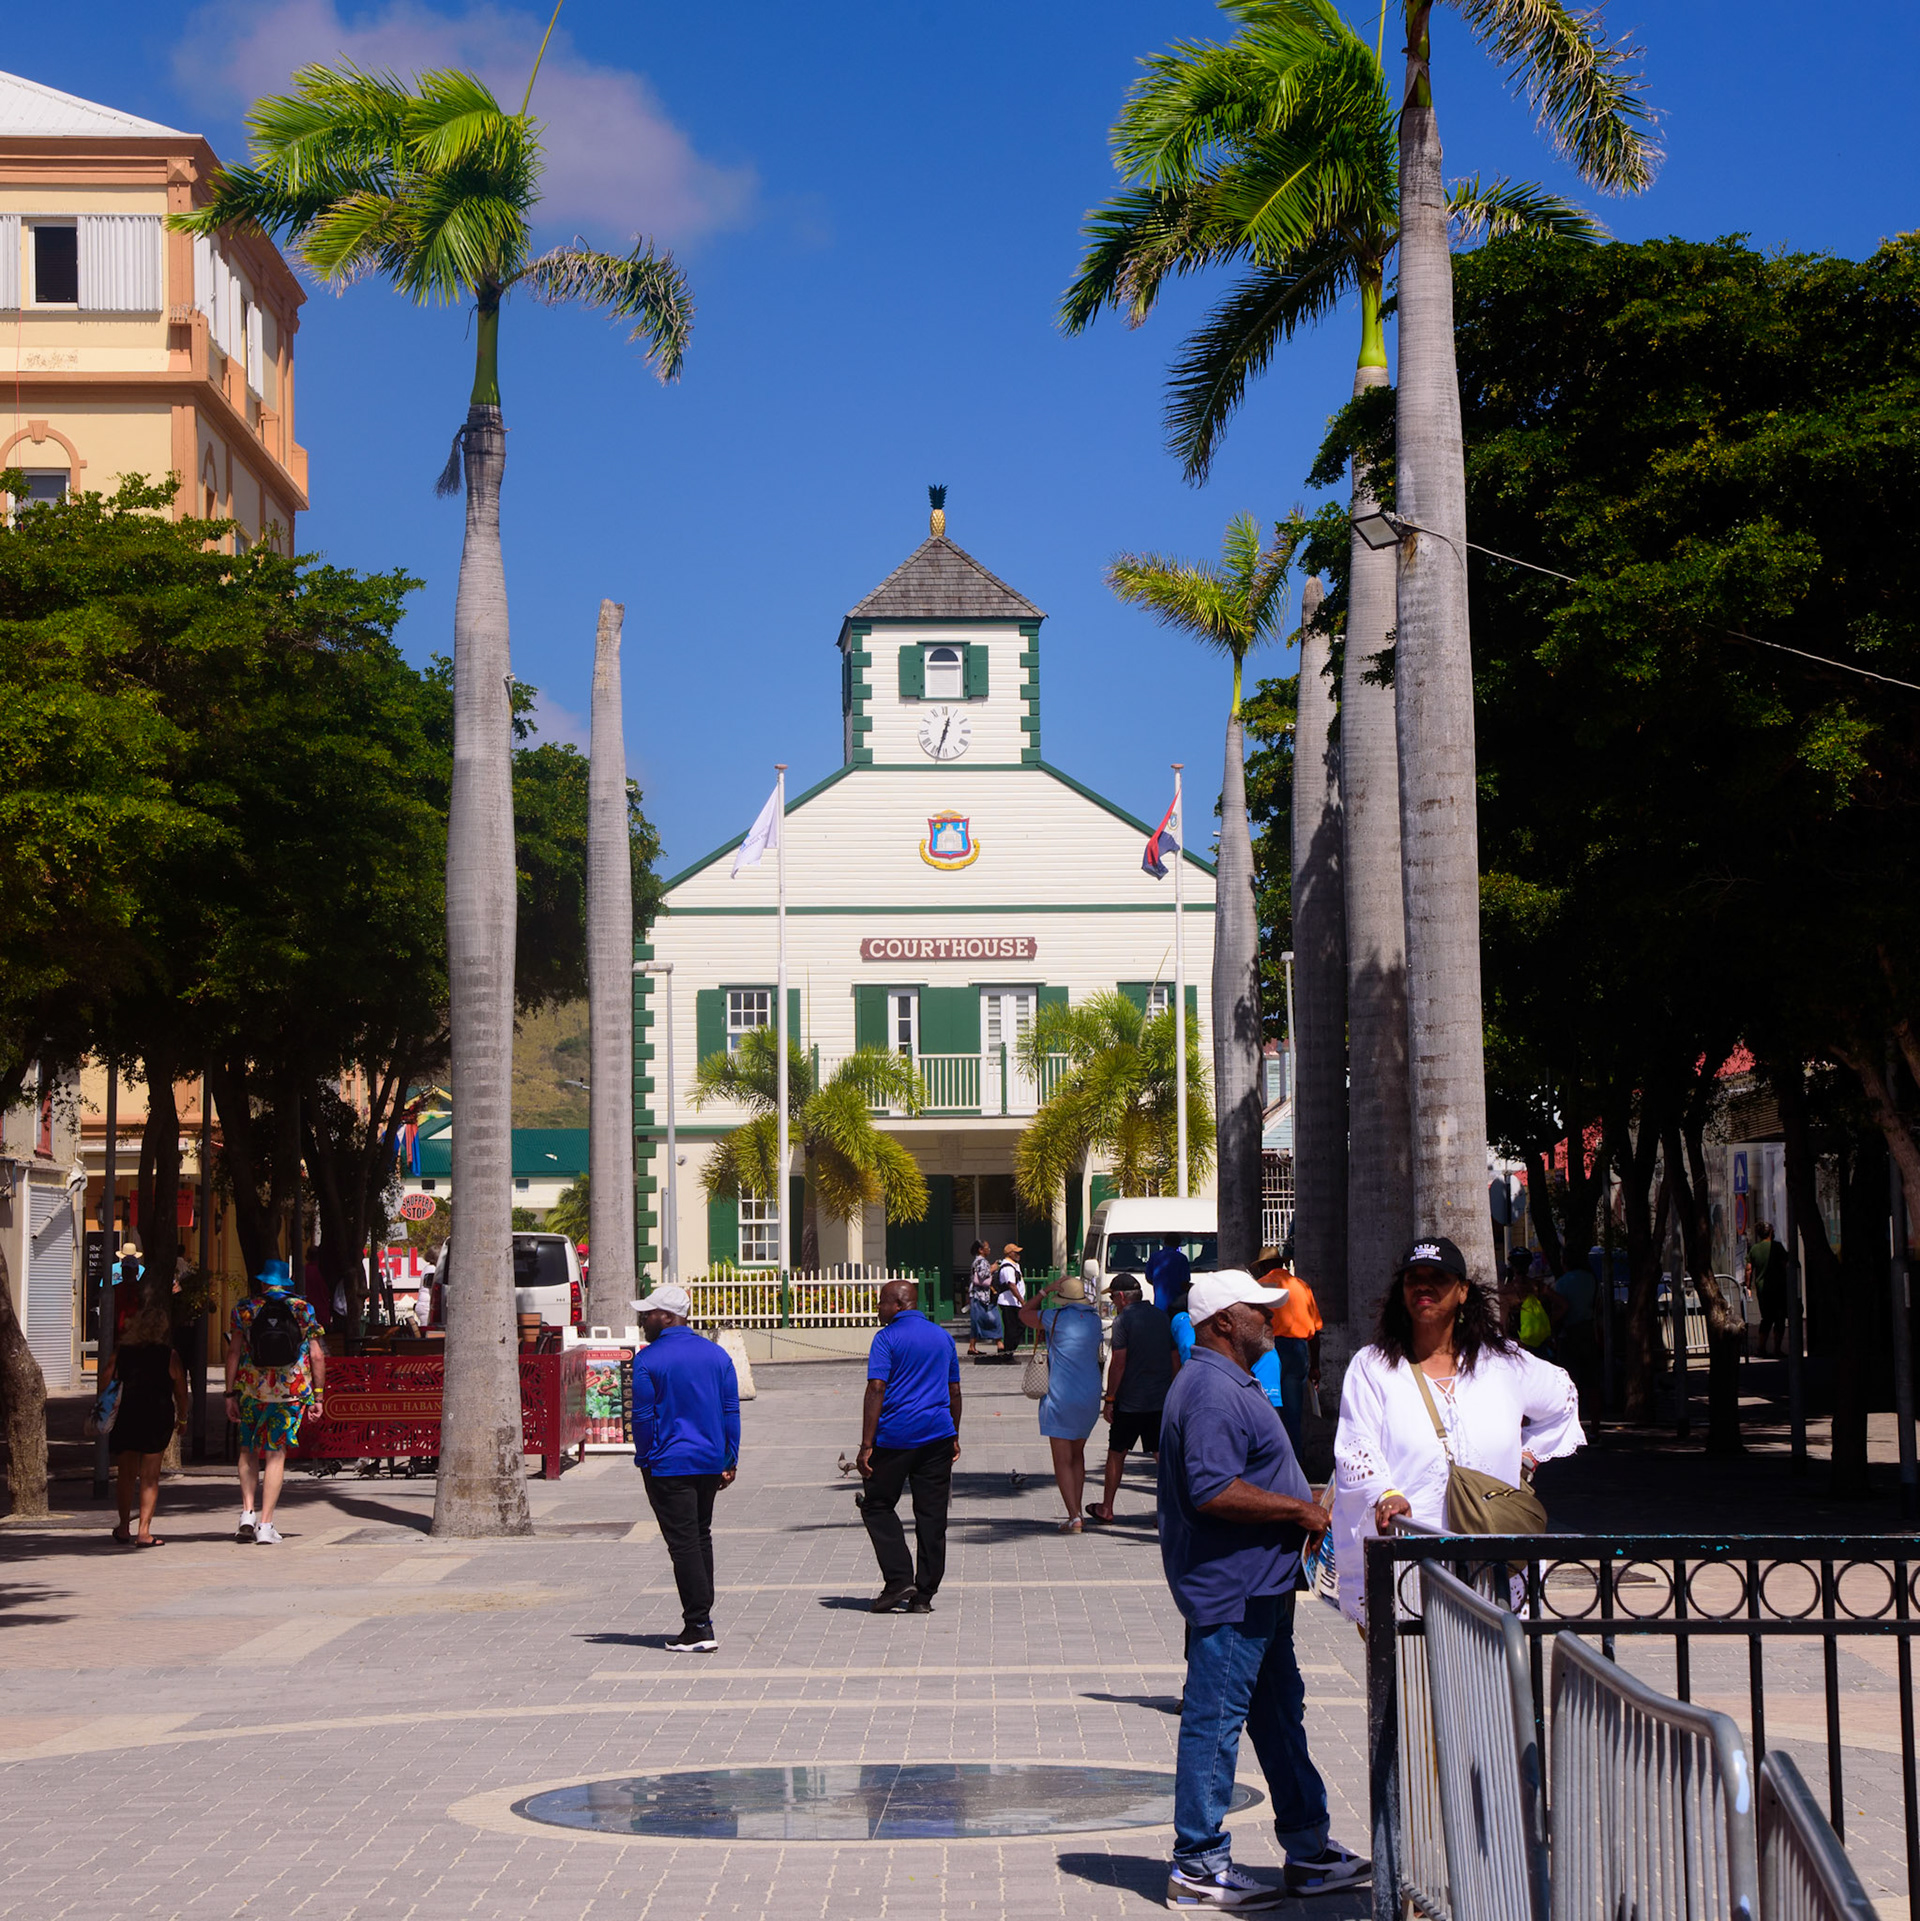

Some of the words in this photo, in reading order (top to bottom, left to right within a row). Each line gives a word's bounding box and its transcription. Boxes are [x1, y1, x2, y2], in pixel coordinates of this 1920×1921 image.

[869, 938, 1029, 958] COURTHOUSE
[402, 1195, 433, 1212] SHOPPERS
[406, 1207, 427, 1218] STOP
[335, 1403, 347, 1412] LA
[349, 1402, 378, 1412] CASA
[382, 1403, 399, 1411] DEL
[402, 1401, 442, 1411] HABAN
